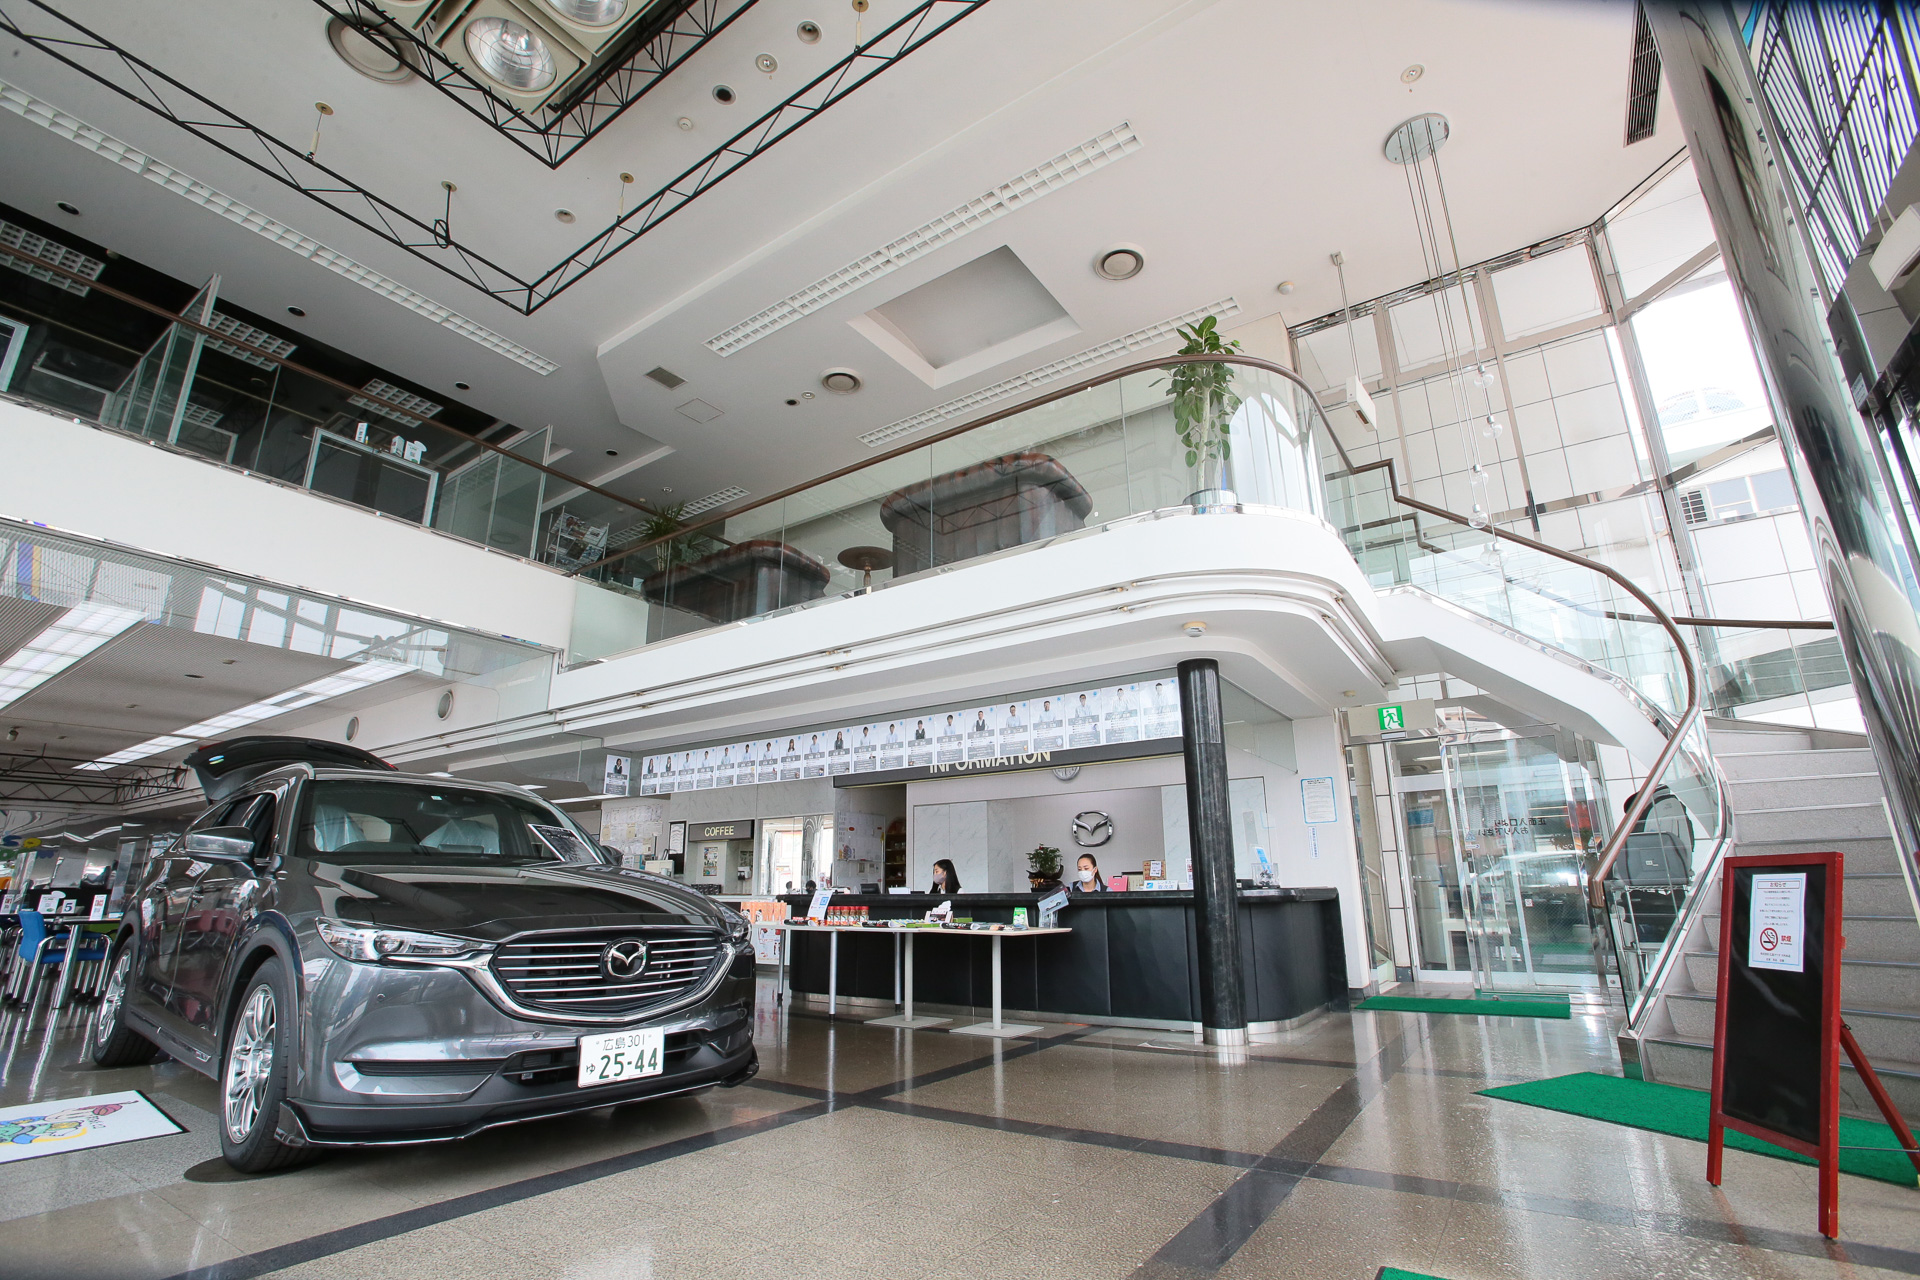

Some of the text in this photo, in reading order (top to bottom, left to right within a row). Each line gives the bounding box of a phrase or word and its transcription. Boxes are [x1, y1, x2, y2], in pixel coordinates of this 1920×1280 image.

[704, 825, 735, 837] COFFEE
[64, 902, 73, 912] 5
[585, 1047, 658, 1080] ゆ 25-44
